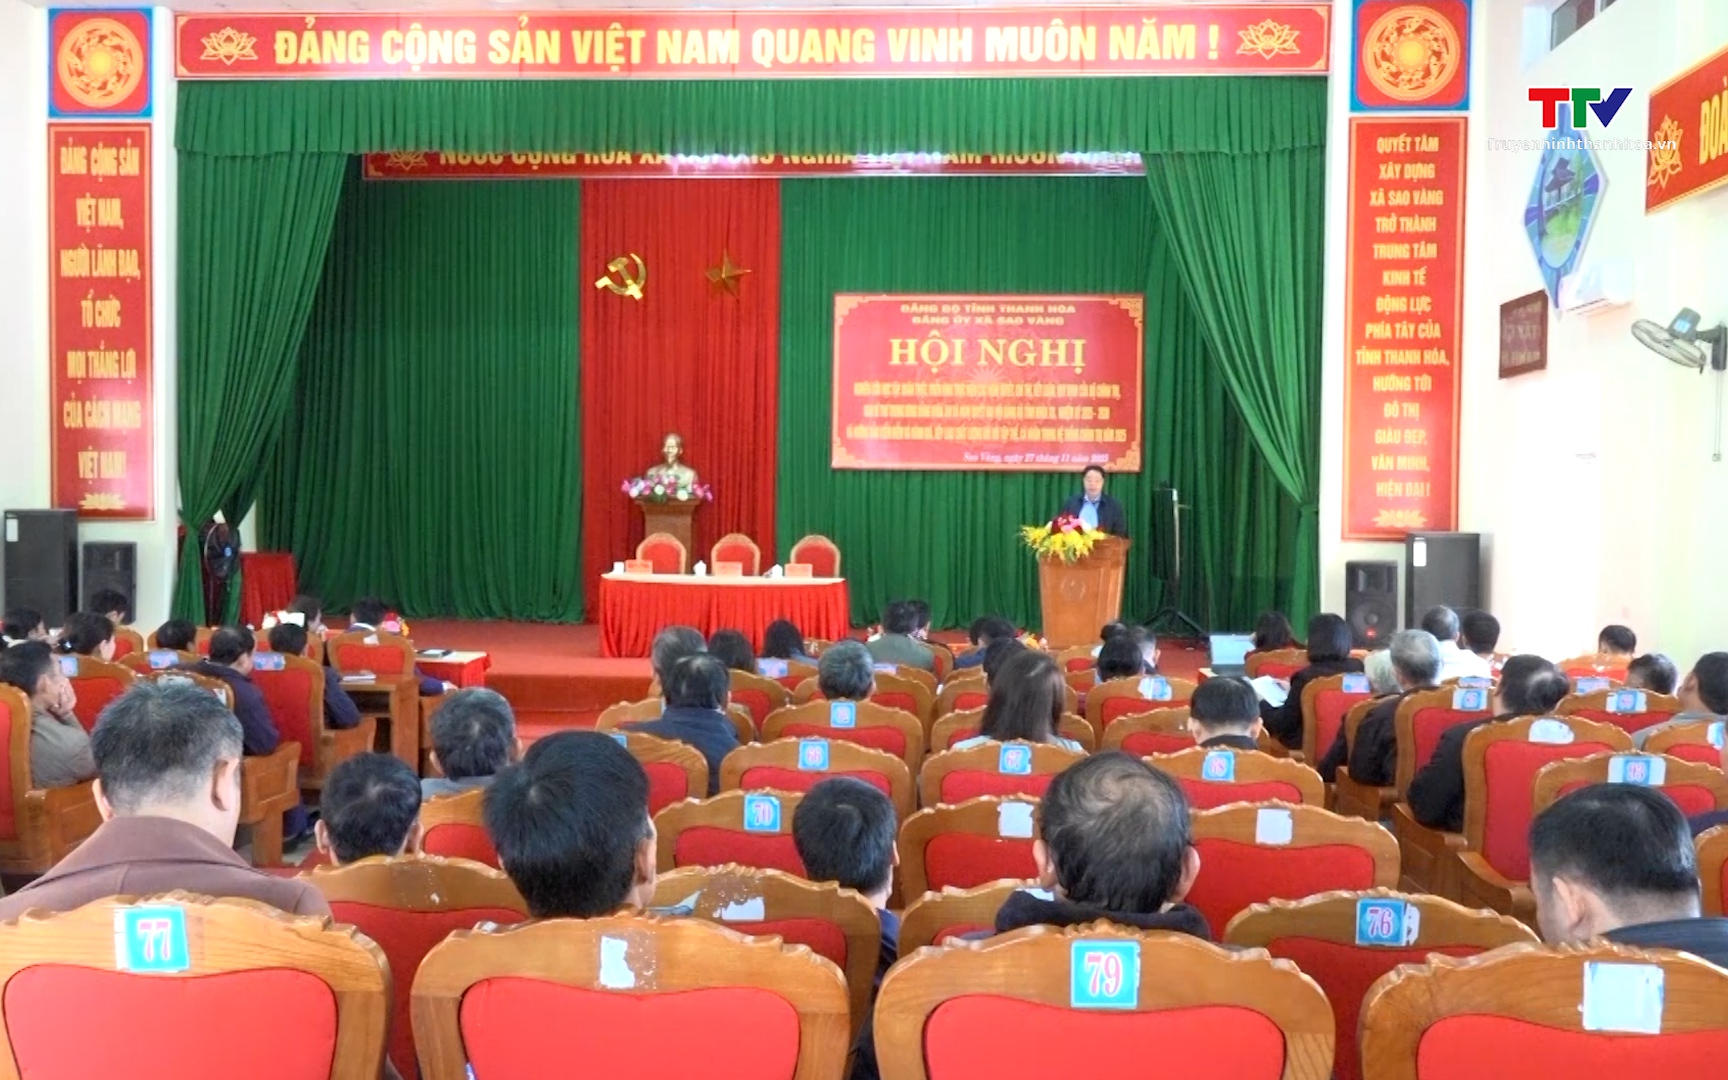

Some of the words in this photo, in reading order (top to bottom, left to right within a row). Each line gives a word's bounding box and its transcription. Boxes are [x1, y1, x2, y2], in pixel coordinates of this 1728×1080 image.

[274, 16, 370, 64] ĐẢNG
[381, 23, 476, 71] CỘNG
[488, 15, 560, 65] SẢN
[571, 22, 646, 72] VIỆT
[657, 30, 739, 64] NAM
[751, 28, 875, 68] QUANG
[887, 27, 973, 62] VINH
[985, 18, 1096, 62] MUÔN
[1109, 17, 1196, 60] NĂM
[1376, 132, 1412, 154] QUYẾT
[1414, 132, 1440, 152] TÂM
[61, 137, 87, 175] ĐẢNG
[91, 141, 118, 182] CỘNG
[119, 137, 139, 177] SẢN
[1379, 161, 1402, 180] XÂY
[1403, 162, 1436, 183] DỰNG
[1369, 187, 1386, 207] XÃ
[1388, 189, 1411, 206] SAO
[1412, 187, 1444, 206] VÀNG
[76, 191, 97, 233] VIỆT
[1375, 212, 1398, 234] TRỞ
[1399, 214, 1437, 233] THÀNH
[1372, 242, 1410, 260] TRUNG
[1412, 241, 1438, 259] TÂM
[1382, 269, 1411, 286] KINH
[1411, 265, 1427, 286] TẾ
[81, 288, 94, 329] TỔ
[999, 304, 1045, 314] THANH
[1376, 293, 1408, 315] ĐỘNG
[1409, 295, 1432, 315] LỰC
[996, 315, 1024, 326] SAO
[1365, 320, 1393, 340] PHÍA
[1394, 319, 1416, 340] TÂY
[1417, 318, 1442, 339] CỦA
[889, 328, 967, 375] HỘI
[976, 338, 1087, 376] NGHỊ
[1355, 346, 1382, 365] TỈNH
[1383, 349, 1422, 365] THANH
[63, 391, 84, 429] CỦA
[1402, 402, 1421, 421] THỊ
[78, 445, 98, 485] VIỆT
[753, 802, 772, 826] 70
[1367, 907, 1393, 938] 76
[137, 919, 171, 962] 77
[1085, 951, 1122, 997] 79
